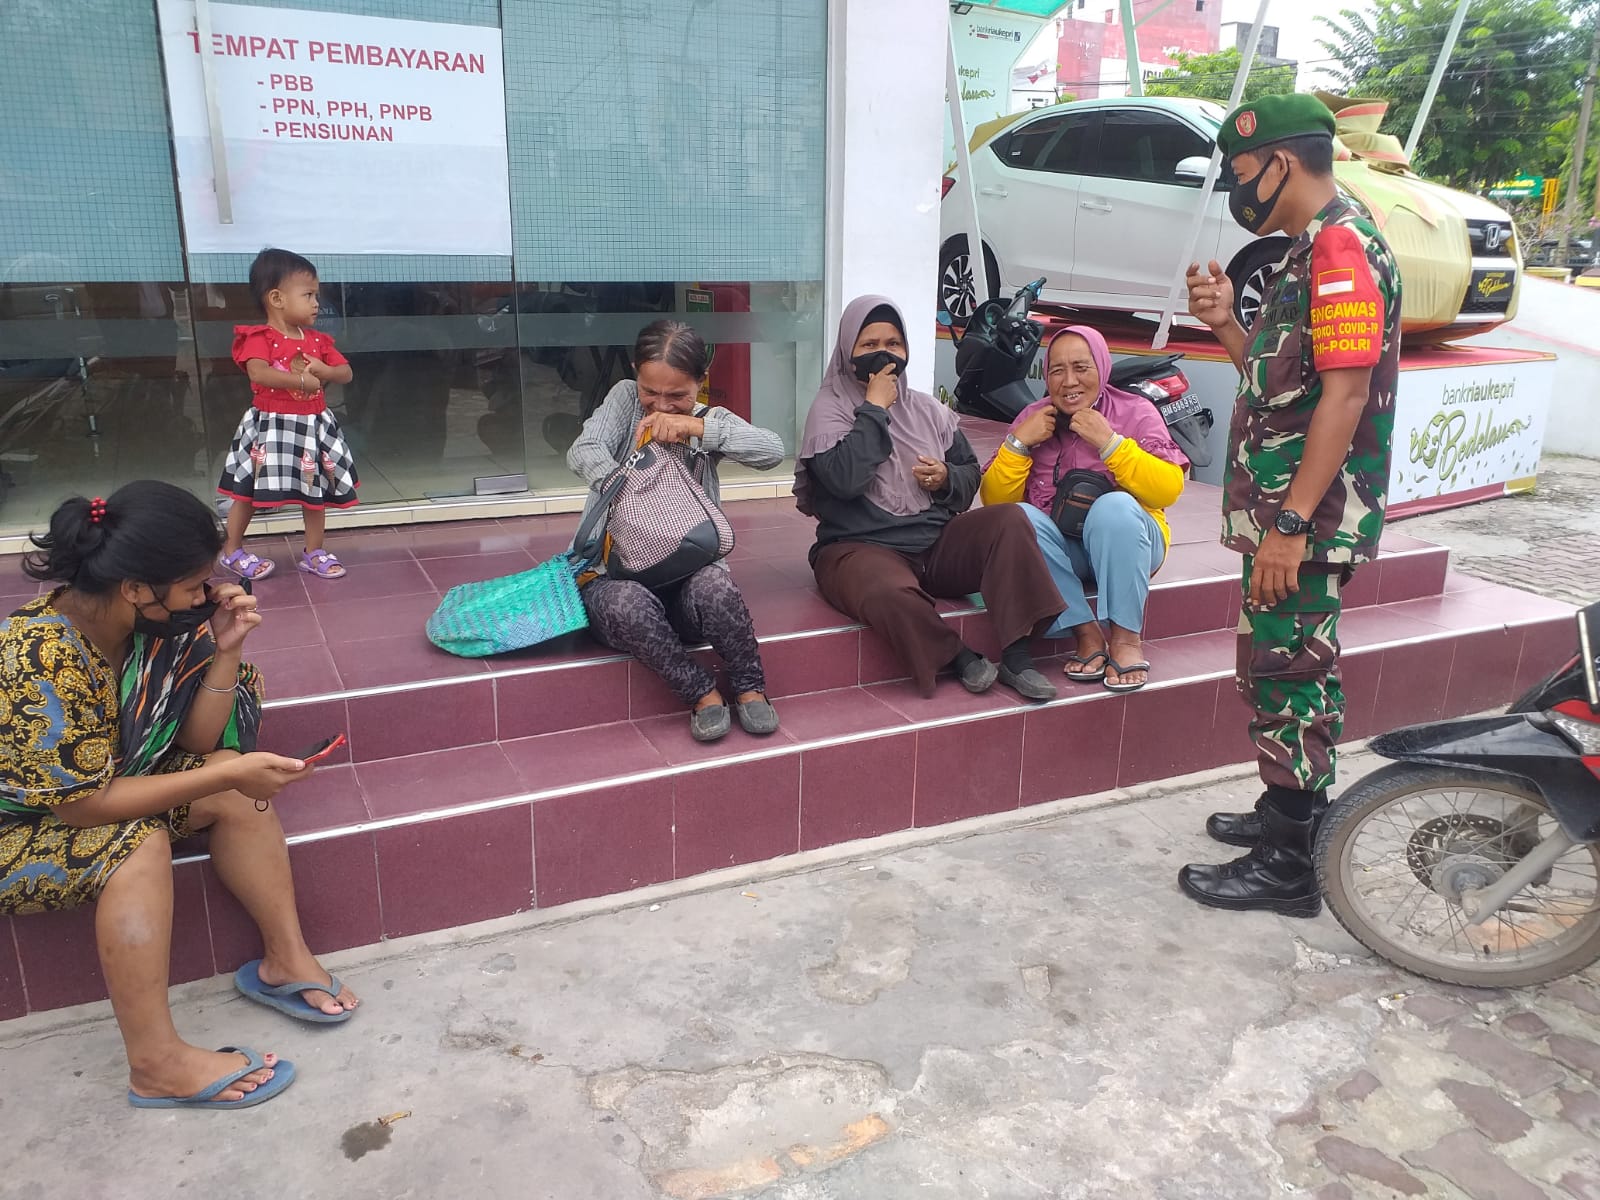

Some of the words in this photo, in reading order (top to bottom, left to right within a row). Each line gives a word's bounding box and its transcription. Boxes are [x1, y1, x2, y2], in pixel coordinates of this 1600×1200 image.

[187, 31, 299, 61] TEMPAT
[309, 41, 485, 74] PEMBAYARAN
[270, 74, 314, 92] PBB
[273, 98, 321, 118] PPN,
[327, 101, 373, 119] PPH,
[379, 104, 432, 121] PNPB
[275, 121, 393, 142] PENSIUNAN
[1311, 301, 1377, 324] ENGAWAS
[1338, 322, 1379, 335] COVID-19
[1442, 377, 1516, 406] bankriaukepri
